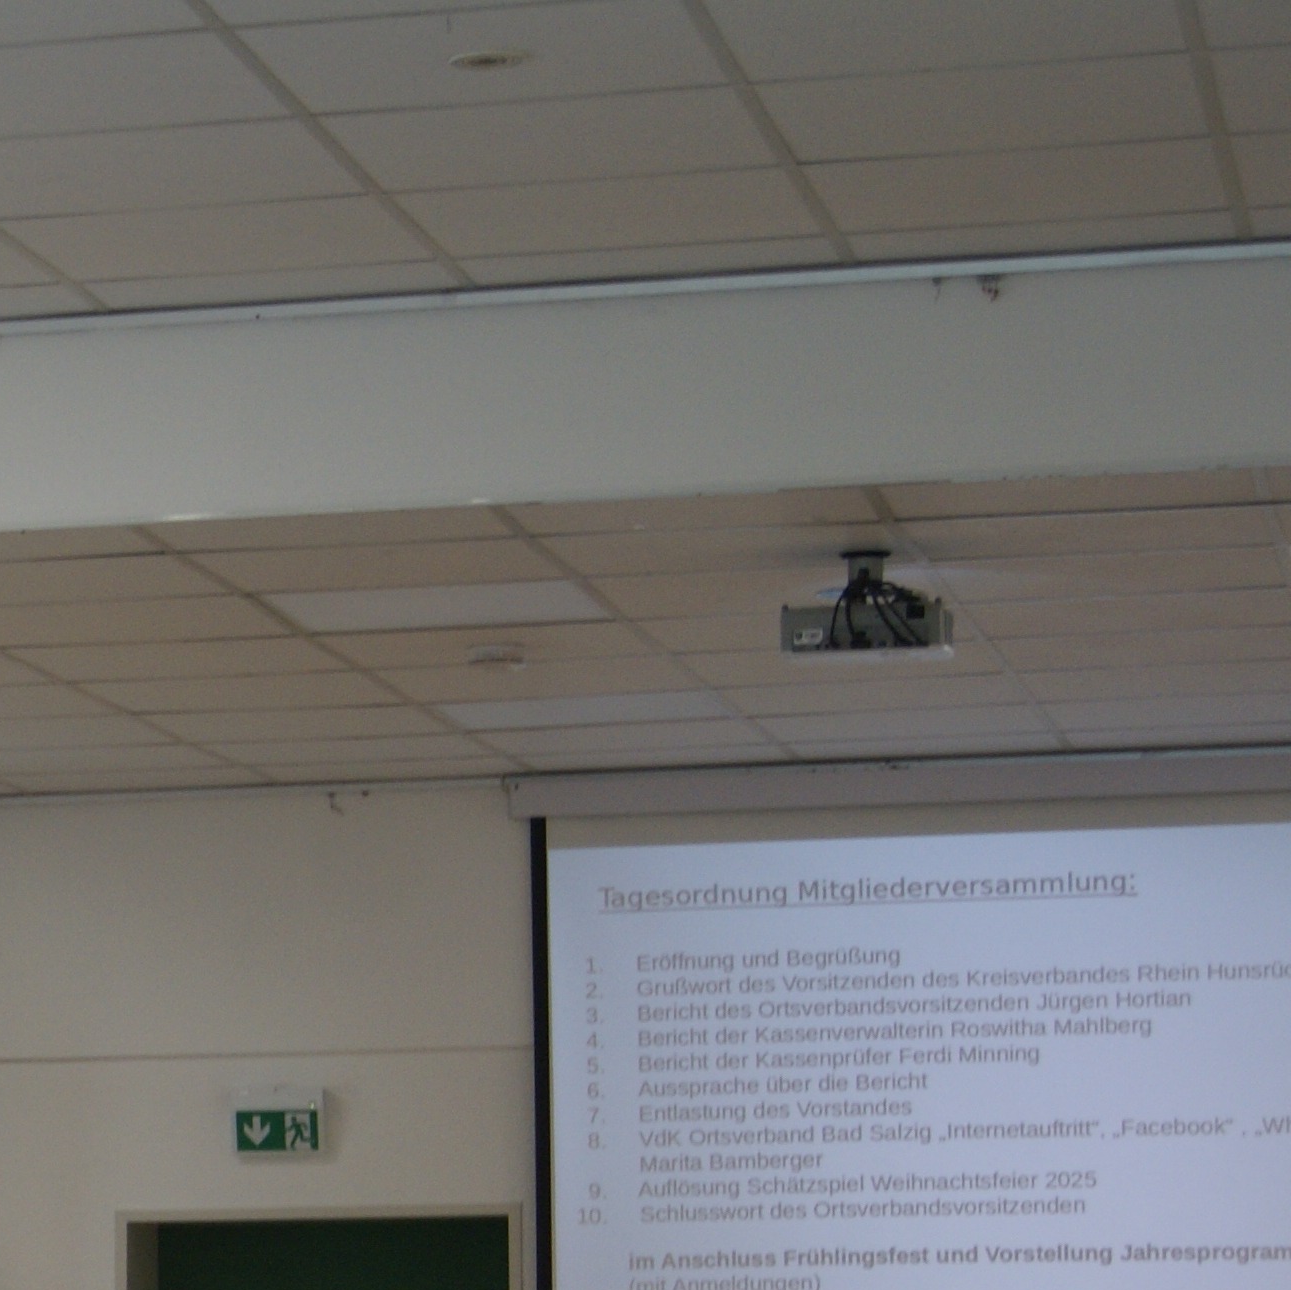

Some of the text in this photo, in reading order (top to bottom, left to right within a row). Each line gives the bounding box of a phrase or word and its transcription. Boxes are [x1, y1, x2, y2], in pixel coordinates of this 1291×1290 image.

[598, 872, 1136, 909] Tagesordnung Mitgliederversammlung:
[586, 946, 902, 974] 1. Eröffnung und Begrüßung
[586, 983, 603, 1000] 2.
[636, 976, 732, 997] Grußwort
[738, 975, 776, 994] des
[781, 970, 916, 992] Vorsitzenden
[921, 969, 960, 989] des
[966, 965, 1131, 987] Kreisverbandes
[1137, 963, 1201, 982] Rhein
[587, 1008, 603, 1025] 3.
[637, 1002, 709, 1023] Bericht
[714, 1001, 753, 1020] des
[757, 995, 1030, 1018] Ortsverbandsvorsitzenden
[1036, 992, 1109, 1014] Jürgen
[586, 1016, 1153, 1049] 4. Bericht der Kassenverwalterin Roswitha Mahlberg
[587, 1044, 1041, 1075] 5. Bericht der Kassenprüfer Ferdi Minning
[588, 1071, 928, 1100] 6. Aussprache über die Bericht
[589, 1098, 913, 1124] 7. Entlastung des Vorstandes
[588, 1133, 605, 1150] 8.
[638, 1128, 681, 1148] VdK
[688, 1124, 815, 1146] Ortsverband
[821, 1123, 863, 1144] Bad
[869, 1122, 932, 1145] Salzig
[639, 1152, 824, 1173] Marita Bamberger
[589, 1169, 1098, 1200] 9. Auflösung Schätzspiel Weihnachtsfeier 2025
[578, 1197, 1087, 1226] 10. Schlusswort des Ortsverbandsvorsitzenden
[661, 1249, 777, 1270] Anschluss
[782, 1246, 930, 1268] Frühlingsfest
[935, 1244, 979, 1265] und
[984, 1243, 1114, 1267] Vorstellung
